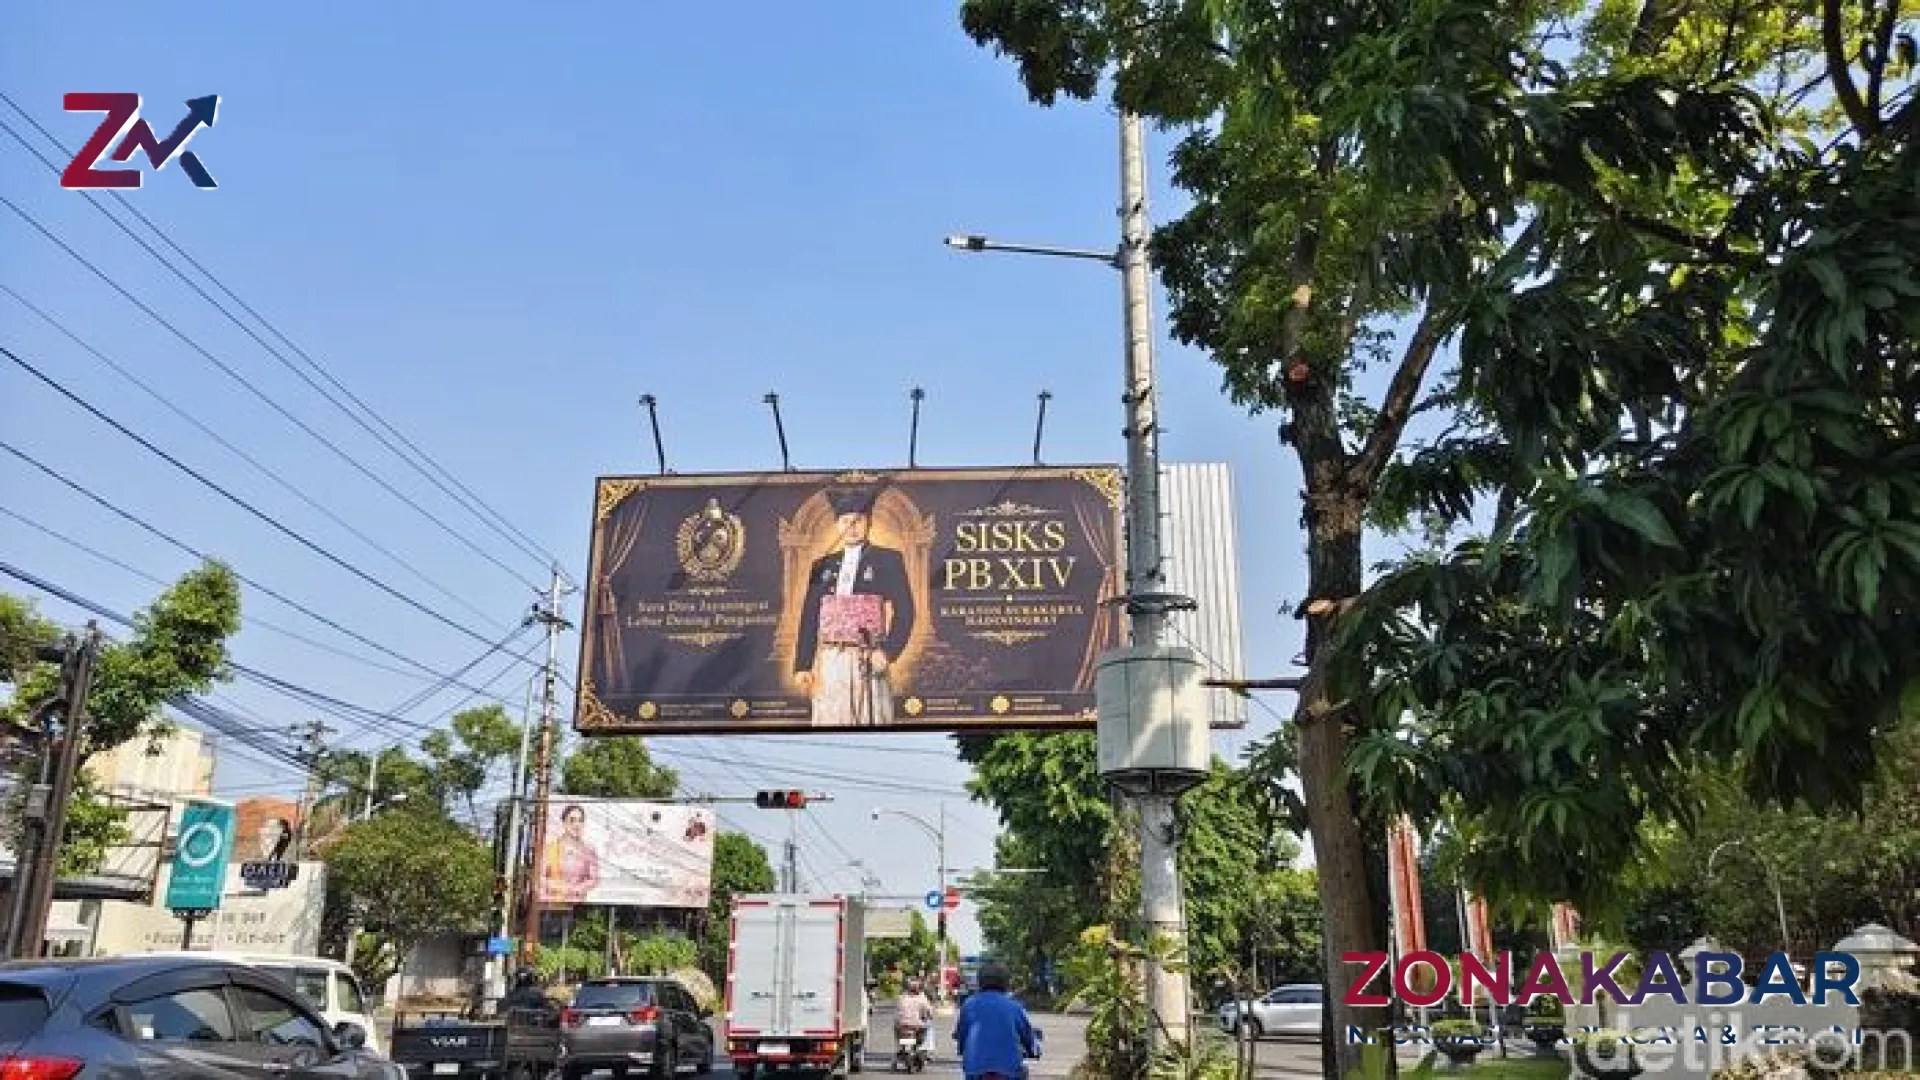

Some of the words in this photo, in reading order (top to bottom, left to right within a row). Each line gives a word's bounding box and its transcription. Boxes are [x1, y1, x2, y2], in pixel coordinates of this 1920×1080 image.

[956, 520, 1066, 552] SISKS
[943, 557, 993, 590] PB
[998, 556, 1077, 590] XIV
